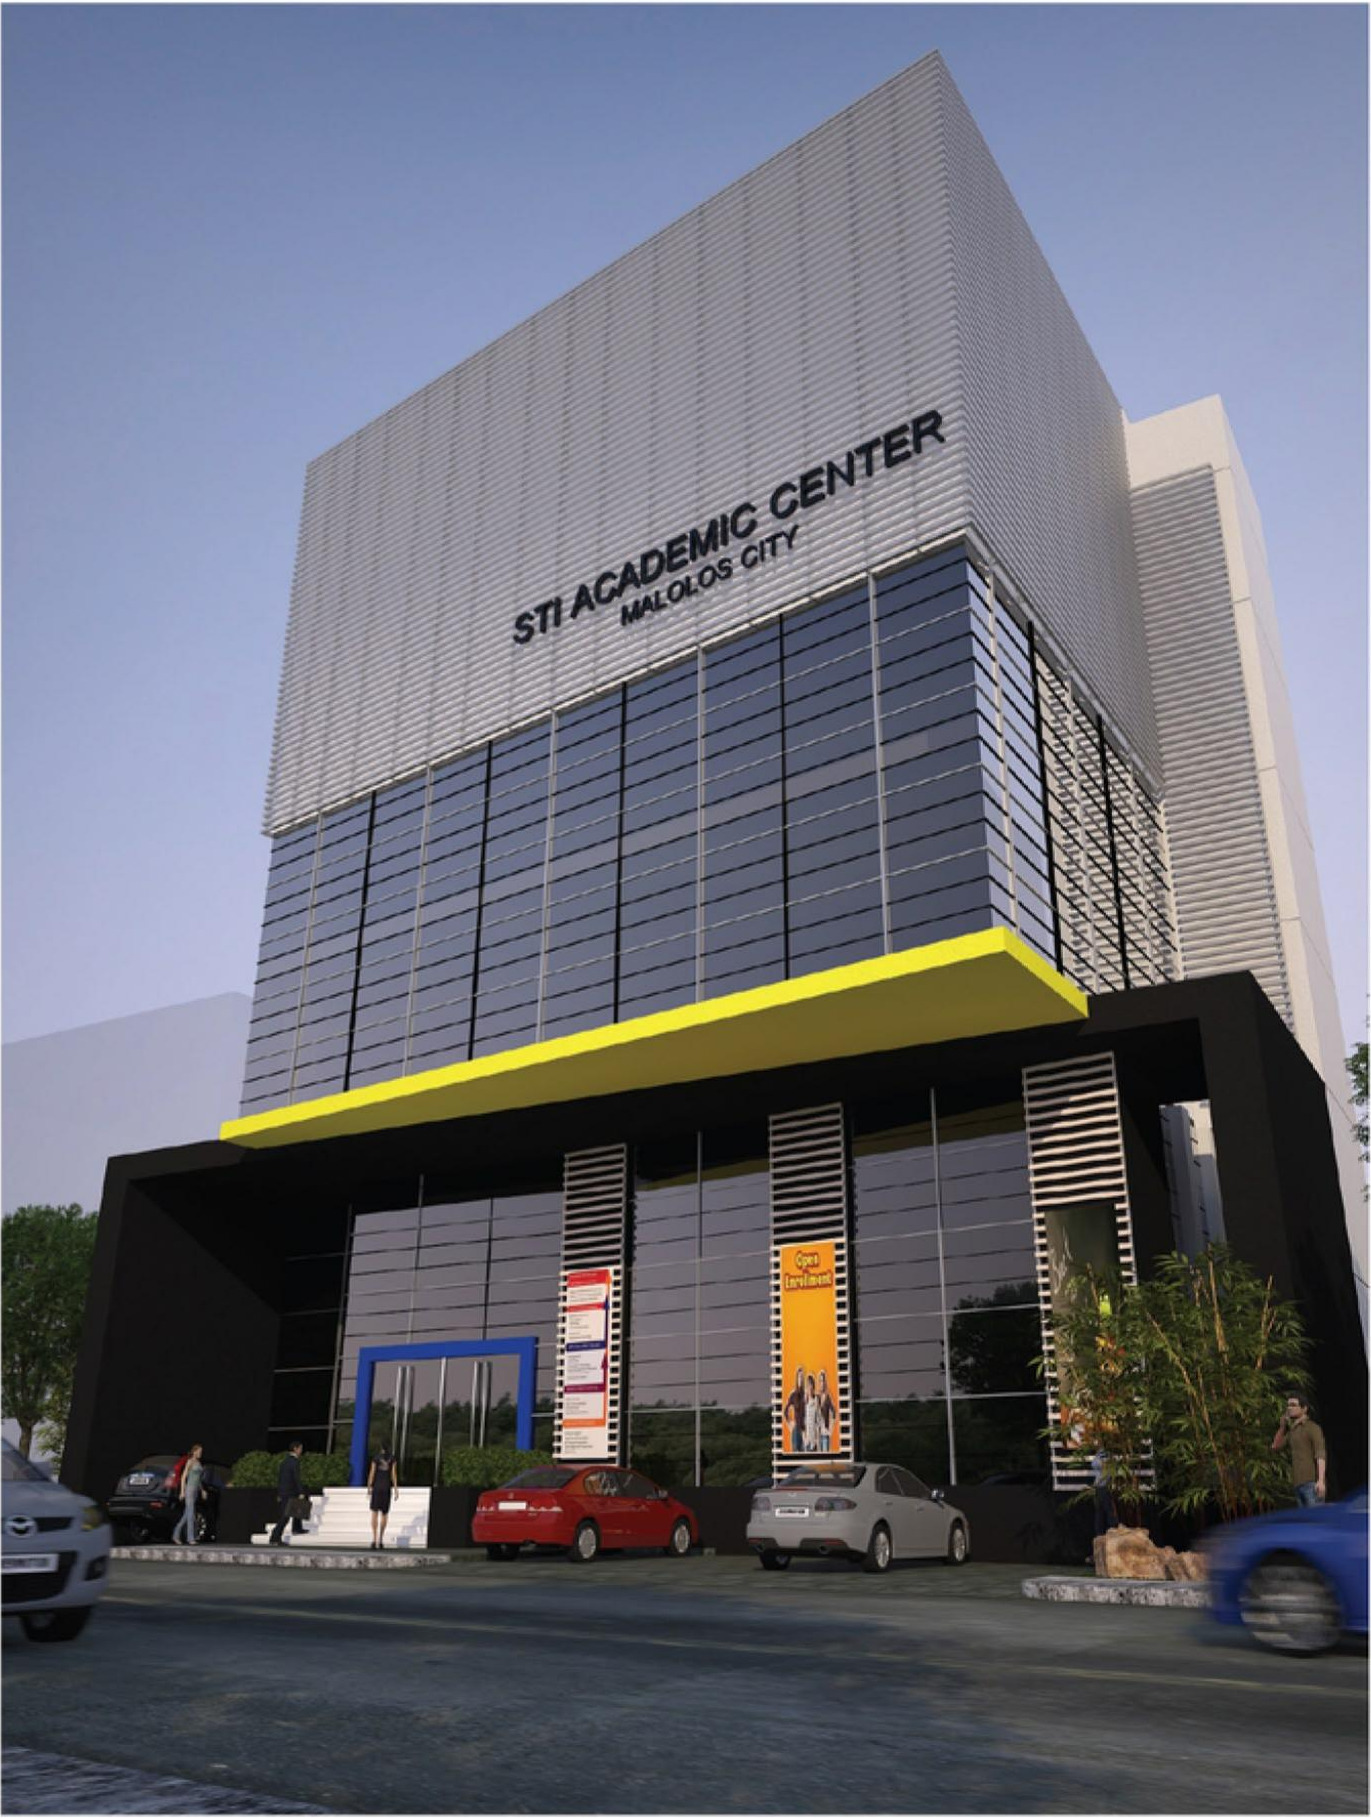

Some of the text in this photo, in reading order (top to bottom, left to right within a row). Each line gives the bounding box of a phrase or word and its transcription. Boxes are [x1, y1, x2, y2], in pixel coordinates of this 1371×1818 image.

[513, 409, 945, 645] STI ACADEMIC CENTER
[620, 524, 799, 627] MALOLOS CITY
[784, 1271, 832, 1289] Enrollment
[796, 1251, 819, 1268] Open
